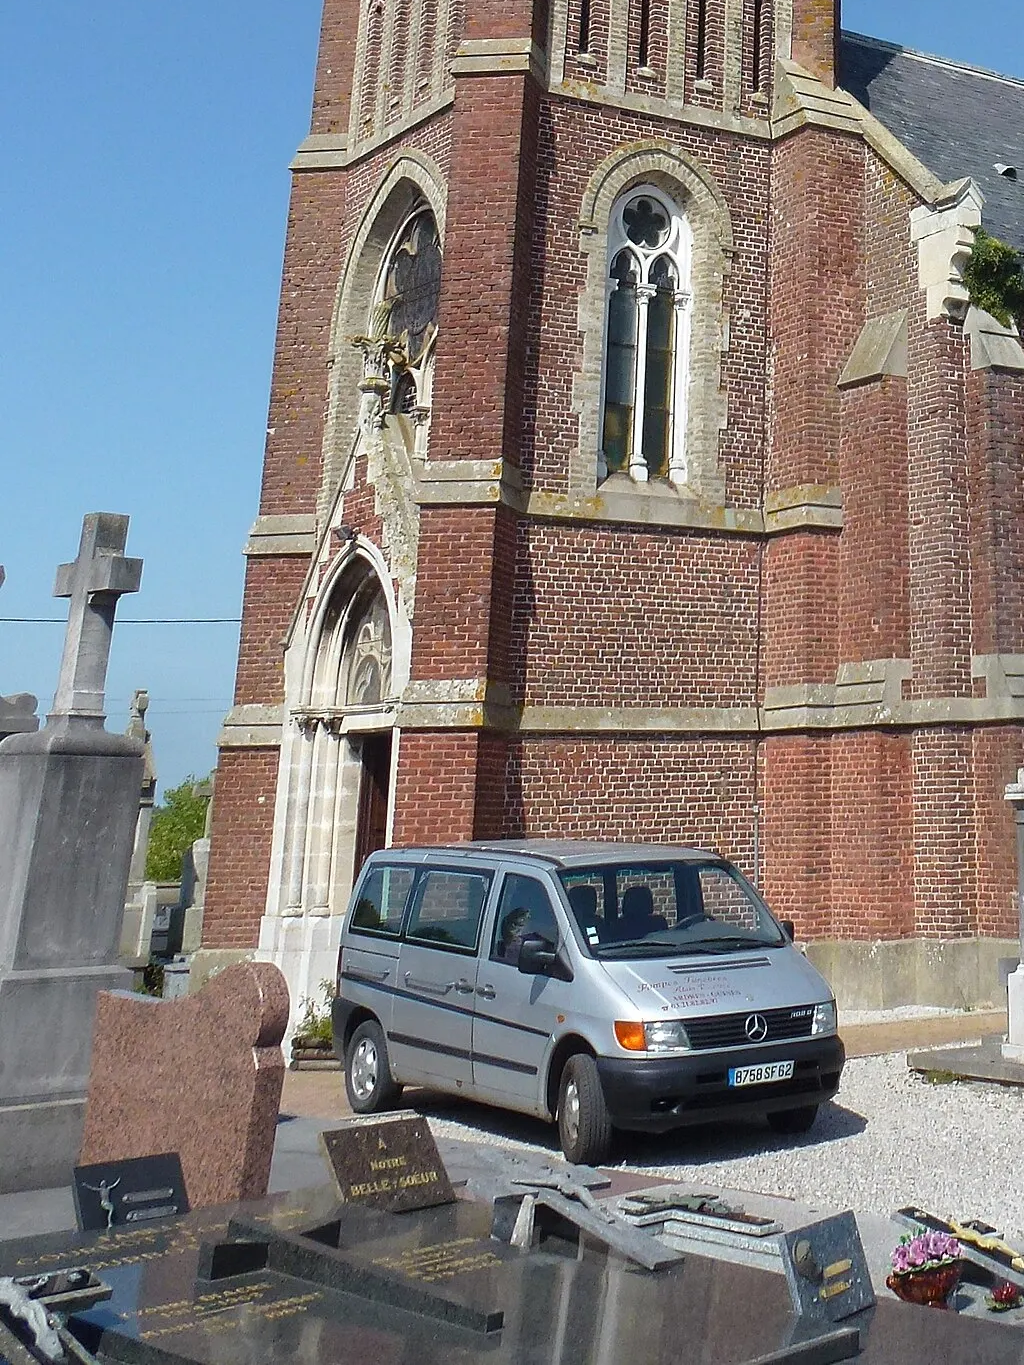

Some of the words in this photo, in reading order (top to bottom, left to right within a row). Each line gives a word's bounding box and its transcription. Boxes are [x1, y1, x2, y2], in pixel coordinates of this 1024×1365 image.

[735, 1068, 763, 1084] 8758
[764, 1065, 778, 1080] SF
[778, 1063, 792, 1077] 62
[369, 1156, 407, 1171] NOTRE
